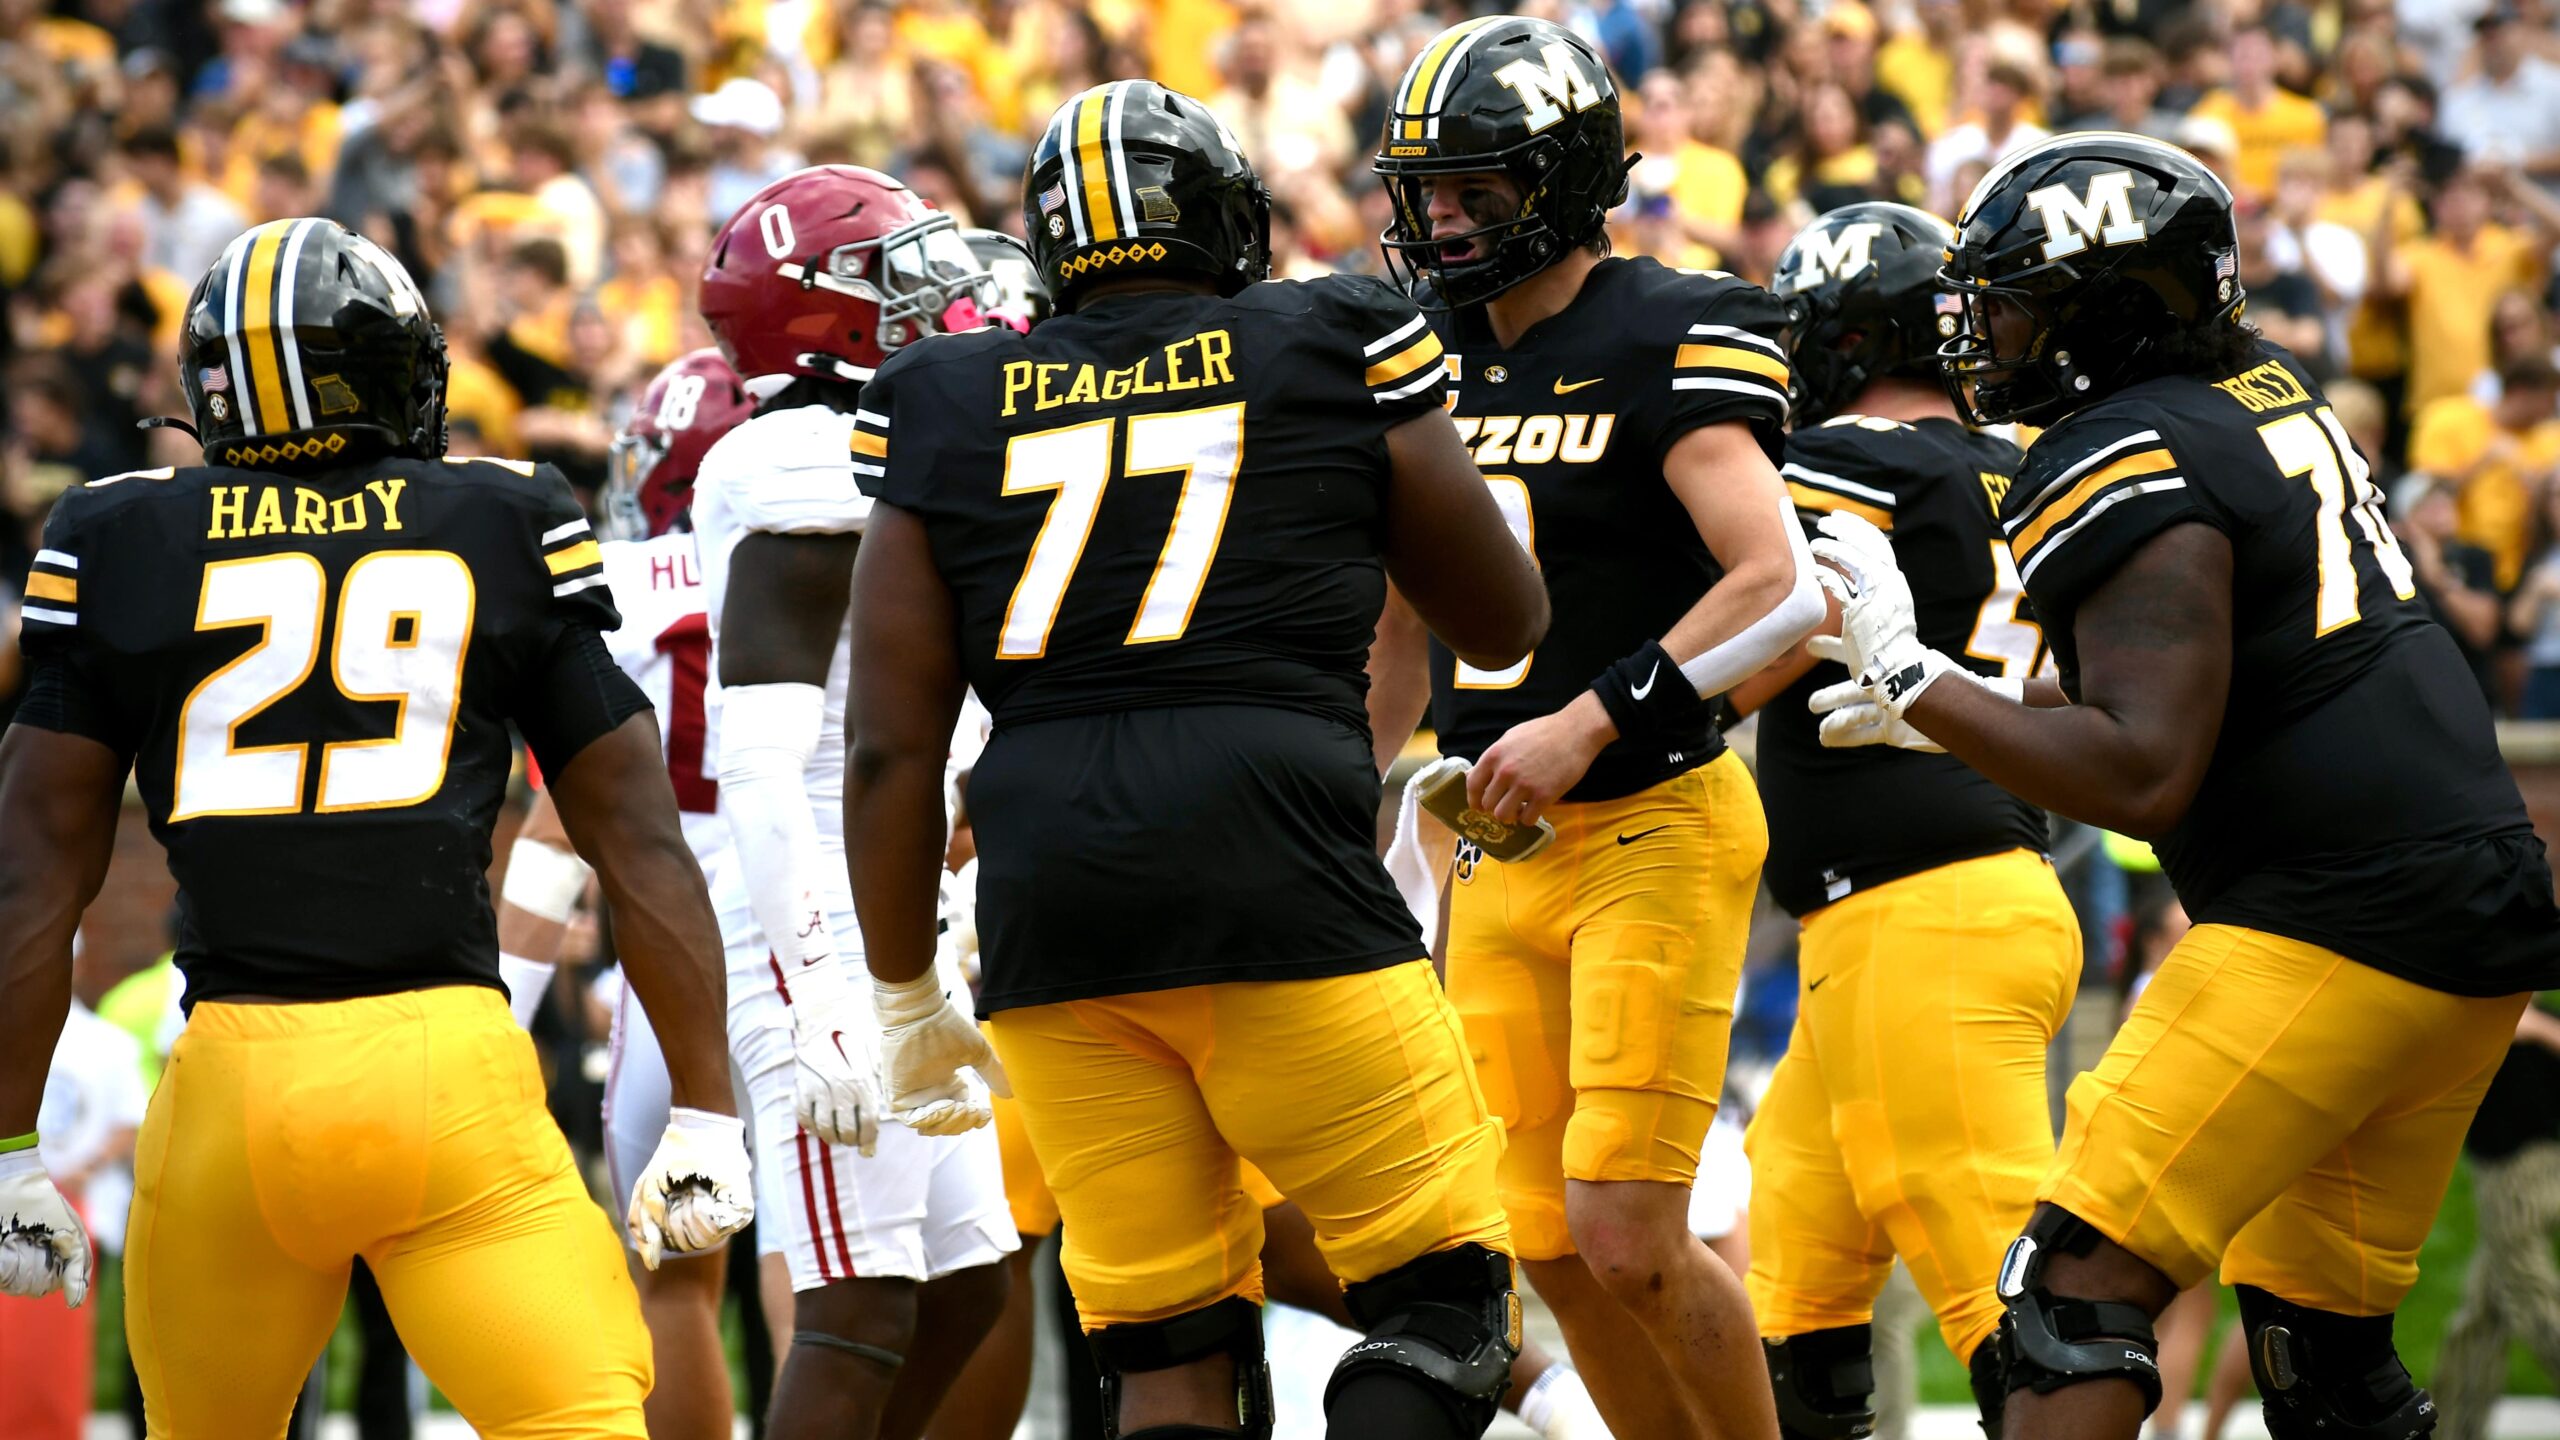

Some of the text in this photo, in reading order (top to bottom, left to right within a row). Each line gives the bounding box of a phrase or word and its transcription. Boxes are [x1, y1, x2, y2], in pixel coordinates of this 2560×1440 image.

[1492, 40, 1601, 135] M
[759, 203, 796, 259] 0
[2026, 169, 2147, 262] M
[1794, 222, 1882, 292] M
[653, 374, 707, 431] 18
[1001, 329, 1234, 417] PEAGLER
[1452, 414, 1616, 465] ZZOU
[207, 479, 407, 539] HARDY
[995, 401, 1246, 660] 77
[1964, 538, 2057, 679] 5
[167, 550, 476, 824] 29
[1668, 751, 1684, 763] M
